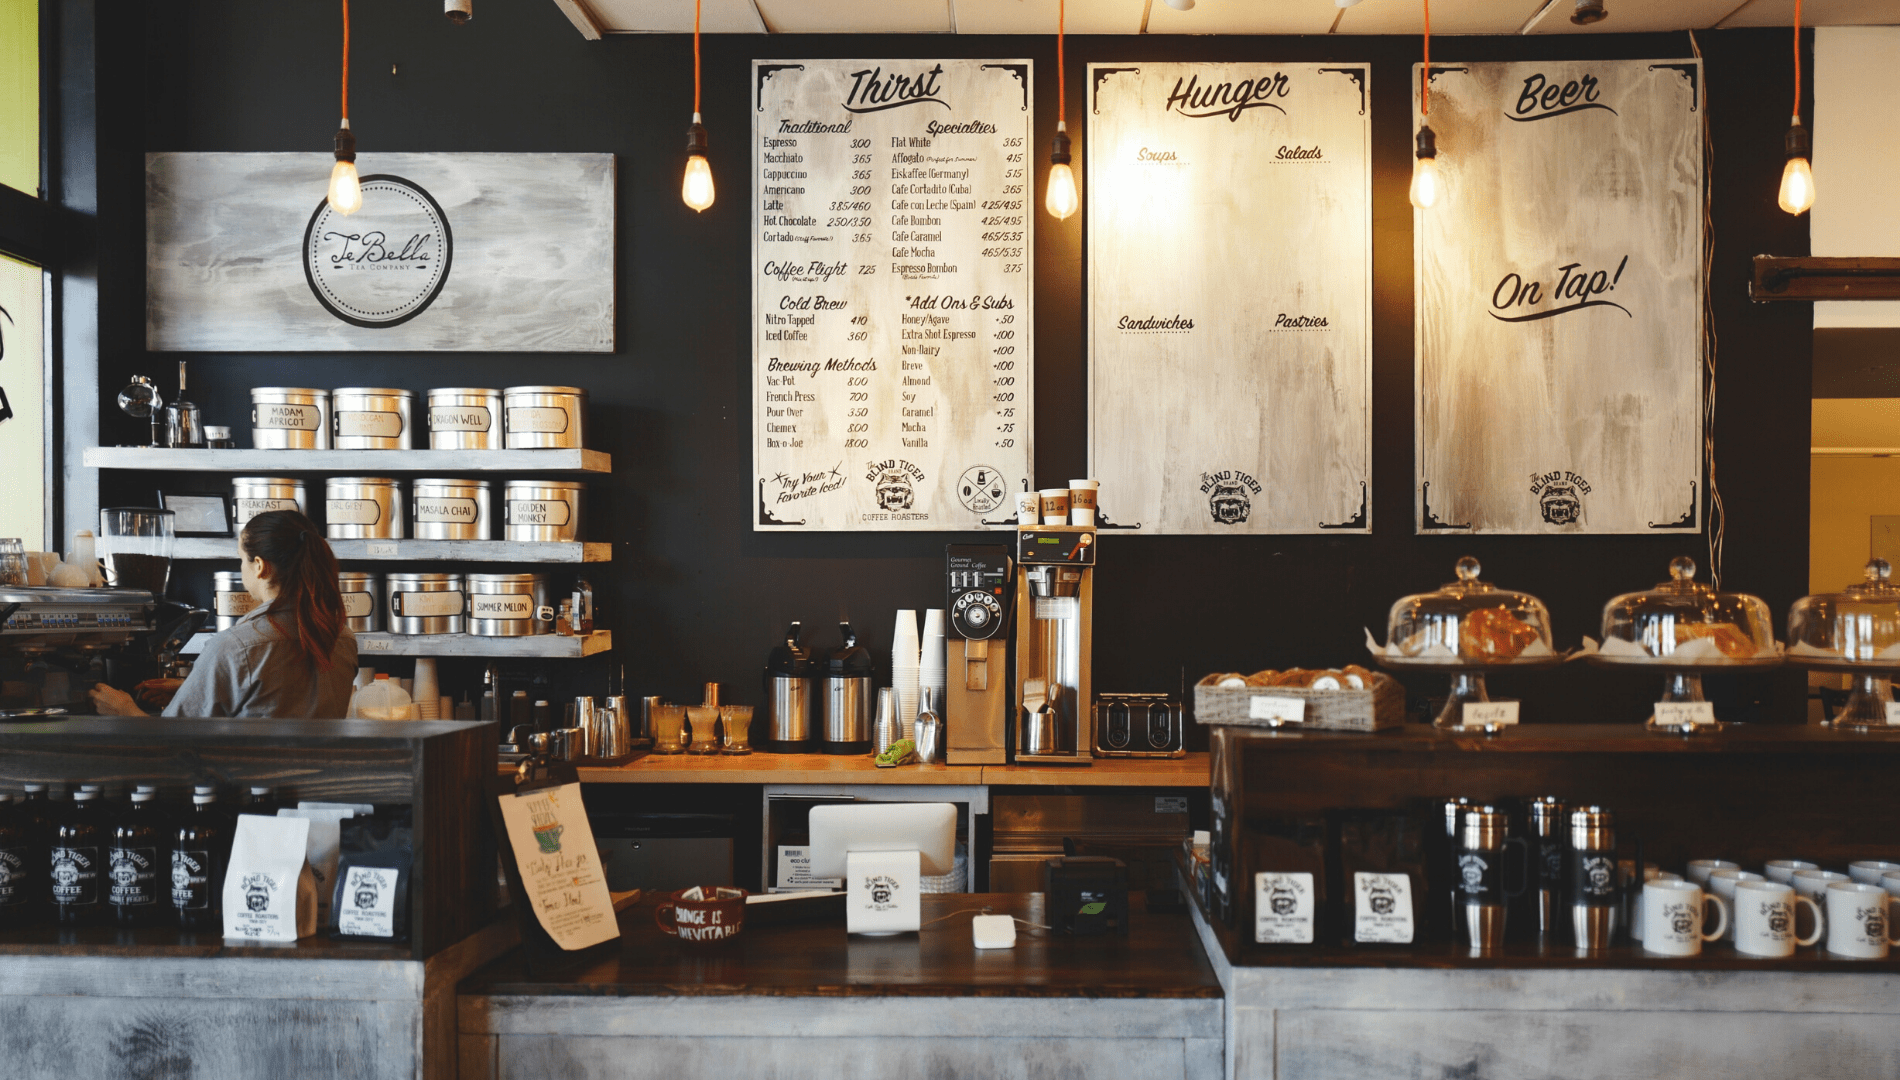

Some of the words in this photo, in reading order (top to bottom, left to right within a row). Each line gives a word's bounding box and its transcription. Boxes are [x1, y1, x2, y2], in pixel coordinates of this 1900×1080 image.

[846, 63, 943, 105] Thirst
[1167, 72, 1290, 122] Hunger
[1516, 73, 1599, 115] Beer
[779, 119, 852, 134] Traditional
[926, 120, 998, 138] Specialties
[763, 137, 797, 150] Espresso
[891, 137, 906, 148] Flat
[909, 137, 931, 148] White
[764, 152, 803, 163] Macchiato
[892, 152, 925, 165] Affogato
[1137, 147, 1177, 163] Soups
[1275, 145, 1323, 160] Salads
[763, 168, 807, 181] Cappuccino
[891, 168, 927, 179] Eiskaffee
[929, 168, 969, 180] (Germany)
[763, 185, 805, 195] Americano
[891, 184, 908, 194] Cafe
[909, 184, 947, 194] Cortadito
[949, 184, 972, 195] (Cuba)
[764, 200, 784, 211] Latte
[891, 199, 909, 210] Cafe
[910, 202, 925, 210] con
[926, 199, 948, 210] Leche
[950, 199, 976, 212] (Spain)
[764, 215, 777, 226] Hot
[779, 215, 817, 226] Chocolate
[891, 215, 909, 226] Cafe
[910, 215, 941, 226] Bombon
[763, 231, 793, 242] Cortado
[892, 231, 909, 242] Cafe
[910, 231, 942, 242] Caramel
[892, 247, 909, 258] Cafe
[910, 247, 935, 258] Mocha
[764, 261, 804, 281] Coffee
[807, 261, 848, 282] Flight
[891, 263, 926, 275] Espresso
[927, 262, 958, 273] Bombon
[1492, 272, 1543, 309] On
[1554, 254, 1628, 303] Tap!
[780, 295, 811, 310] Cold
[814, 295, 848, 310] Brew
[940, 295, 968, 310] Ons
[969, 295, 980, 310] &
[981, 293, 1015, 310] Subs
[765, 314, 786, 325] Nitro
[787, 314, 815, 327] Tapped
[901, 313, 950, 326] Honey/Agave
[1117, 314, 1195, 330] Sandwiches
[1275, 313, 1329, 328] Pastries
[765, 330, 782, 341] Iced
[784, 330, 807, 341] Coffee
[901, 329, 923, 340] Extra
[924, 329, 941, 340] Shot
[943, 329, 976, 342] Espresso
[901, 345, 941, 357] Non-Dairy
[768, 357, 822, 378] Brewing
[824, 357, 878, 371] Methods
[901, 360, 923, 370] Breve
[902, 376, 931, 386] Almond
[766, 390, 792, 402] French
[795, 390, 816, 402] Press
[902, 391, 916, 403] Soy
[271, 407, 303, 417] MADAM
[766, 406, 784, 417] Pour
[786, 406, 803, 417] Over
[902, 406, 934, 417] Caramel
[269, 417, 305, 427] APRICOT
[433, 414, 459, 425] DRAGON
[460, 414, 483, 426] WELL
[766, 422, 797, 433] Chemex
[901, 422, 926, 432] Mocha
[766, 437, 804, 448] Box-o-Joe
[902, 438, 928, 448] Vanilla
[866, 460, 895, 482] BLIND
[899, 460, 925, 482] TIGER
[782, 476, 800, 492] Try
[802, 472, 827, 485] Your
[1200, 470, 1231, 494] BLIND
[1235, 470, 1262, 495] TIGER
[1529, 471, 1561, 495] BLIND
[1565, 471, 1592, 496] TIGER
[776, 486, 817, 504] Favorite
[819, 476, 847, 494] Iced!
[1073, 494, 1082, 504] 16
[420, 505, 450, 515] MASALA
[451, 506, 471, 516] CHAI
[517, 503, 547, 513] GOLDEN
[1020, 500, 1027, 513] 8
[1045, 501, 1055, 511] 12
[517, 513, 547, 523] MONKEY
[862, 513, 888, 521] COFFEE
[891, 513, 929, 521] ROASTERS
[971, 562, 987, 570] Coffee
[476, 602, 502, 612] SUMMER
[504, 603, 528, 612] MELON
[67, 850, 91, 868] TIGER
[126, 850, 150, 869] TIGER
[181, 854, 201, 873] TIGER
[884, 875, 900, 890] TIGER
[53, 886, 82, 894] COFFEE
[112, 886, 141, 894] COFFEE
[712, 910, 722, 925] IS
